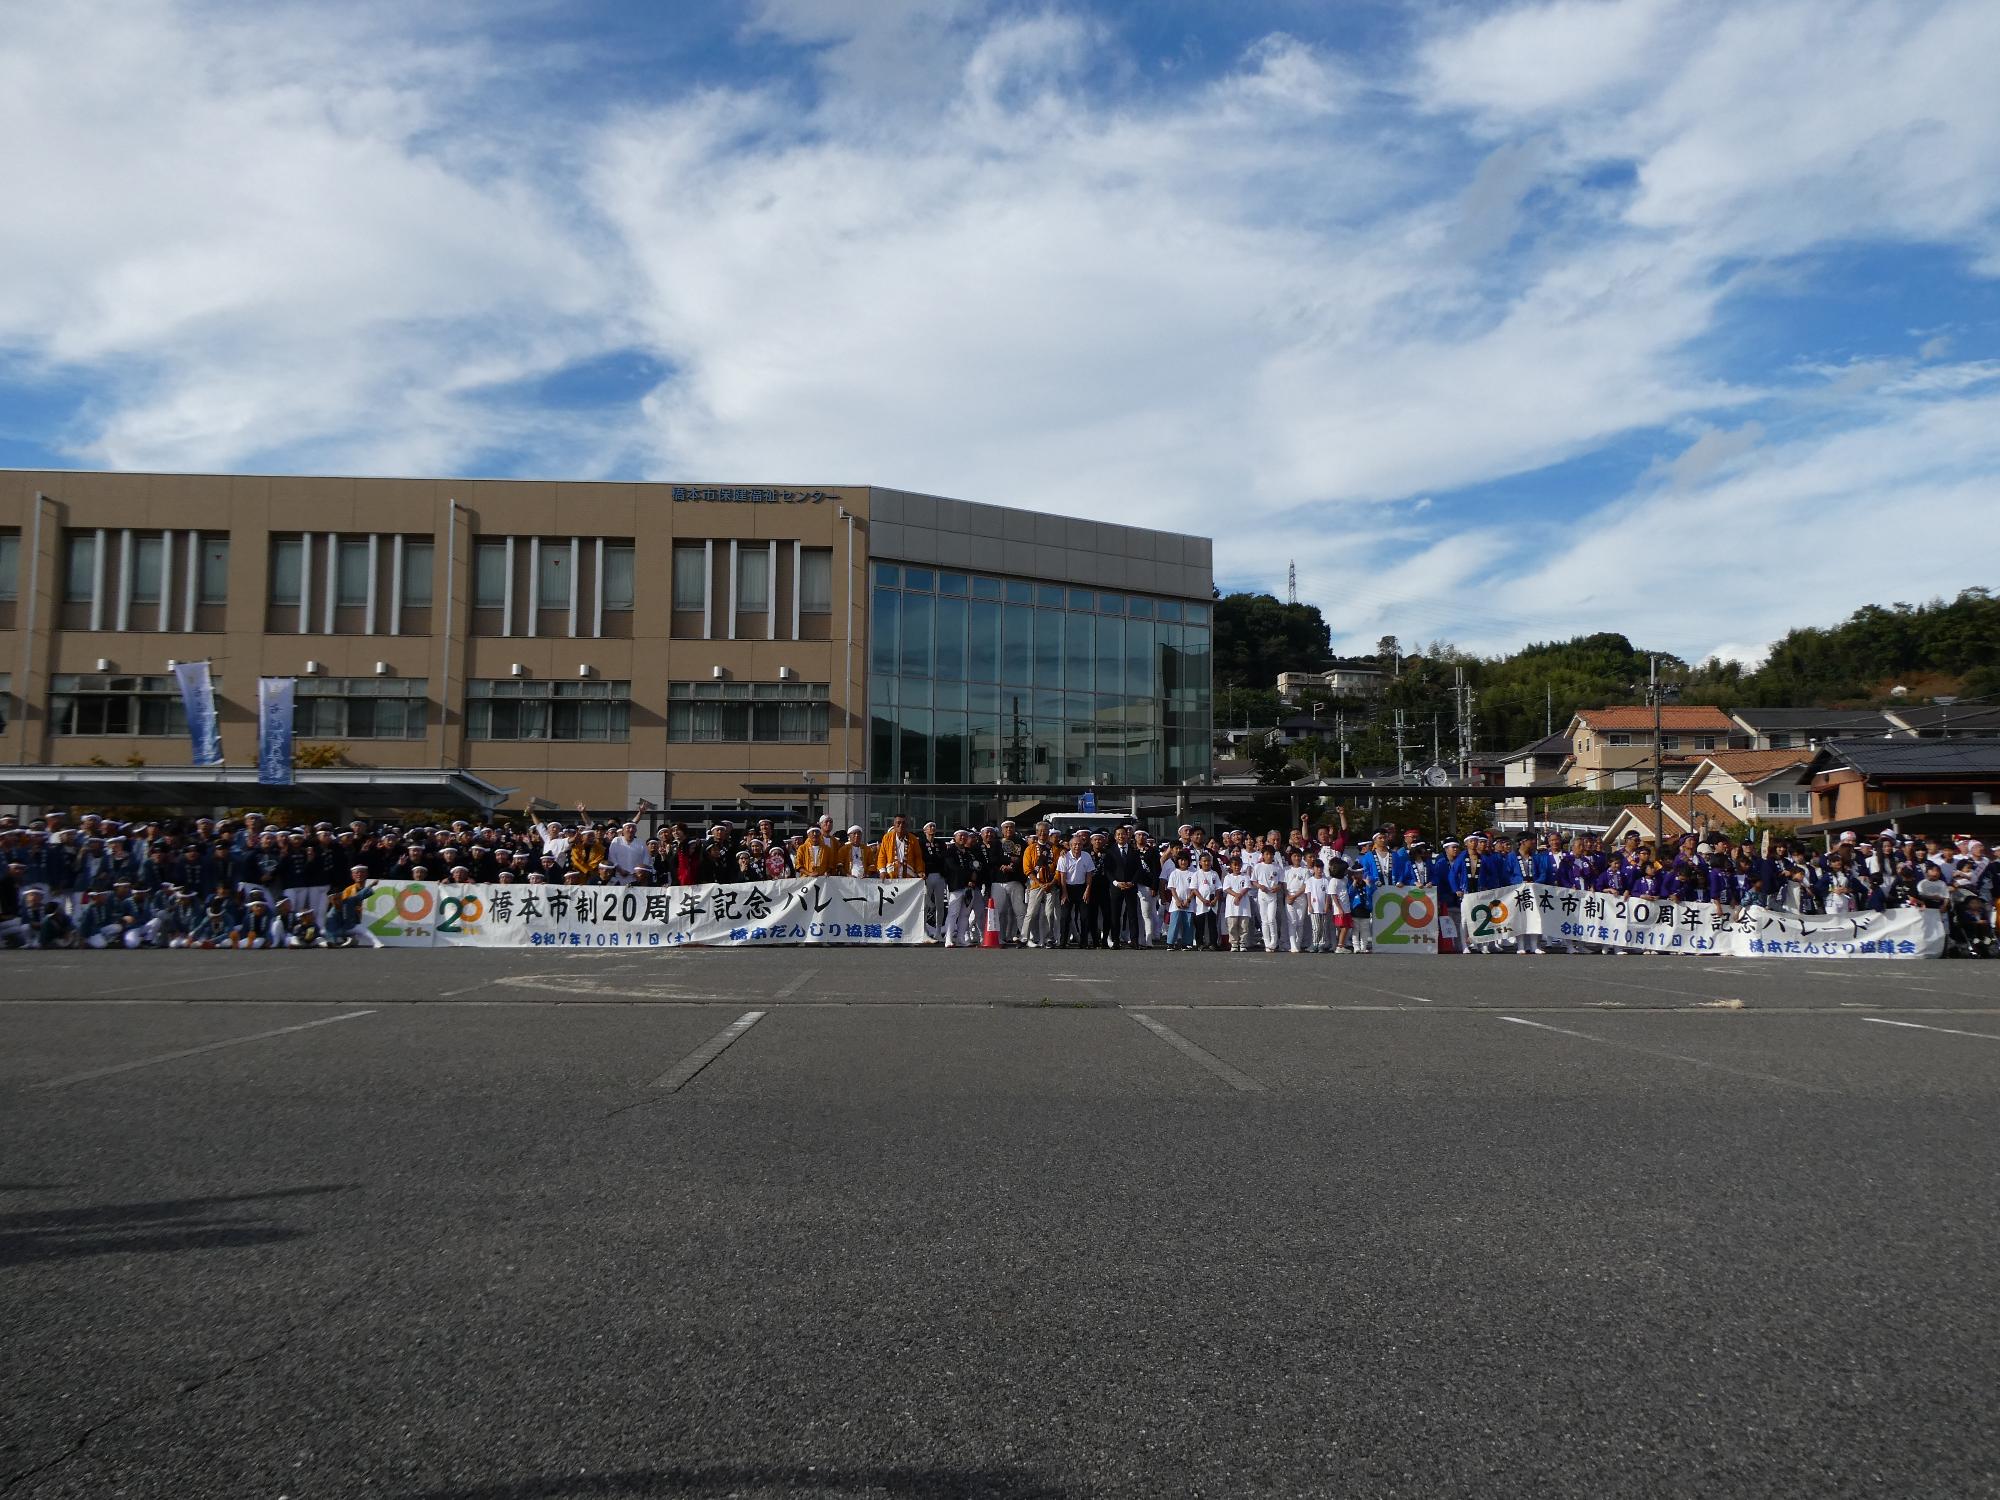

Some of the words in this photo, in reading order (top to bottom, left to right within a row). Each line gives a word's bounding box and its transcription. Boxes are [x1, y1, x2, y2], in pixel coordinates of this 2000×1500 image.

[672, 487, 843, 504] 橋本市保健福祉センター
[488, 884, 899, 925] 橋本市制20周年記念パレード
[1514, 888, 1871, 939] 橋本市制20周年記念パレード
[729, 922, 904, 941] 橋本だんじり協議会
[1749, 938, 1916, 955] 橋本だんじり協議会
